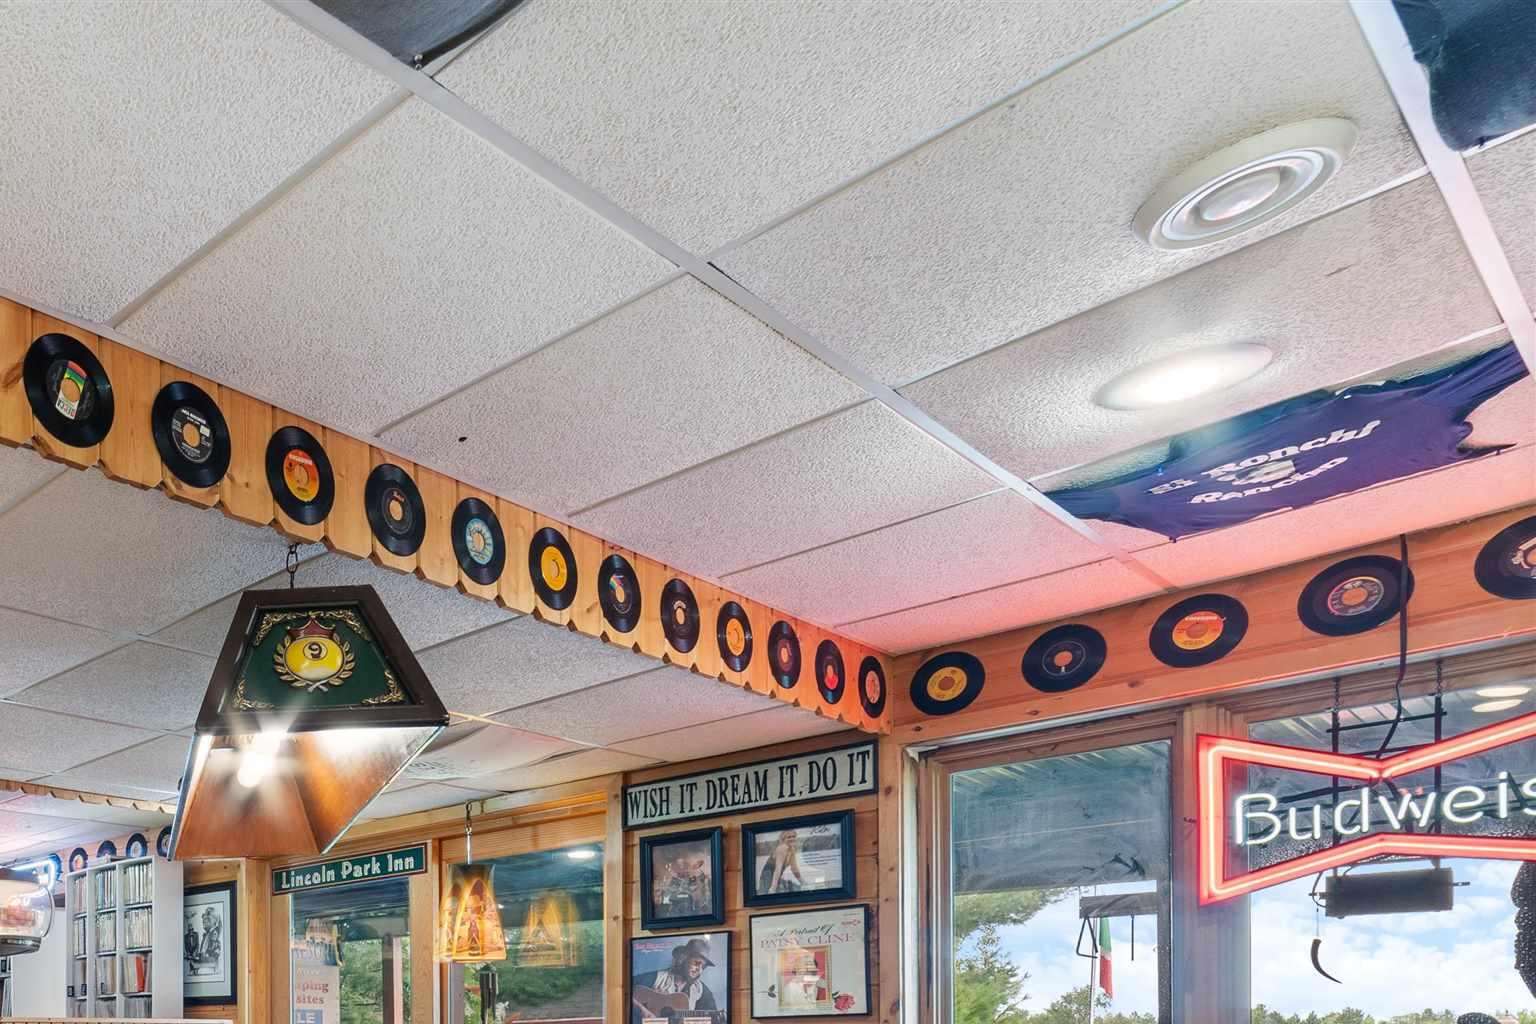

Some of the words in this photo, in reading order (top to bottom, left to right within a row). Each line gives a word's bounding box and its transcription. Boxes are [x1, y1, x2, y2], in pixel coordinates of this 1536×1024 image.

[307, 642, 323, 660] 9
[627, 785, 671, 820] WISH
[705, 769, 768, 811] DREAM
[808, 756, 838, 794] DO
[847, 749, 871, 787] IT
[281, 865, 335, 889] Lincoln
[341, 856, 381, 879] Park
[387, 853, 415, 872] Inn
[759, 937, 802, 949] PATSY
[806, 932, 856, 945] CLINE
